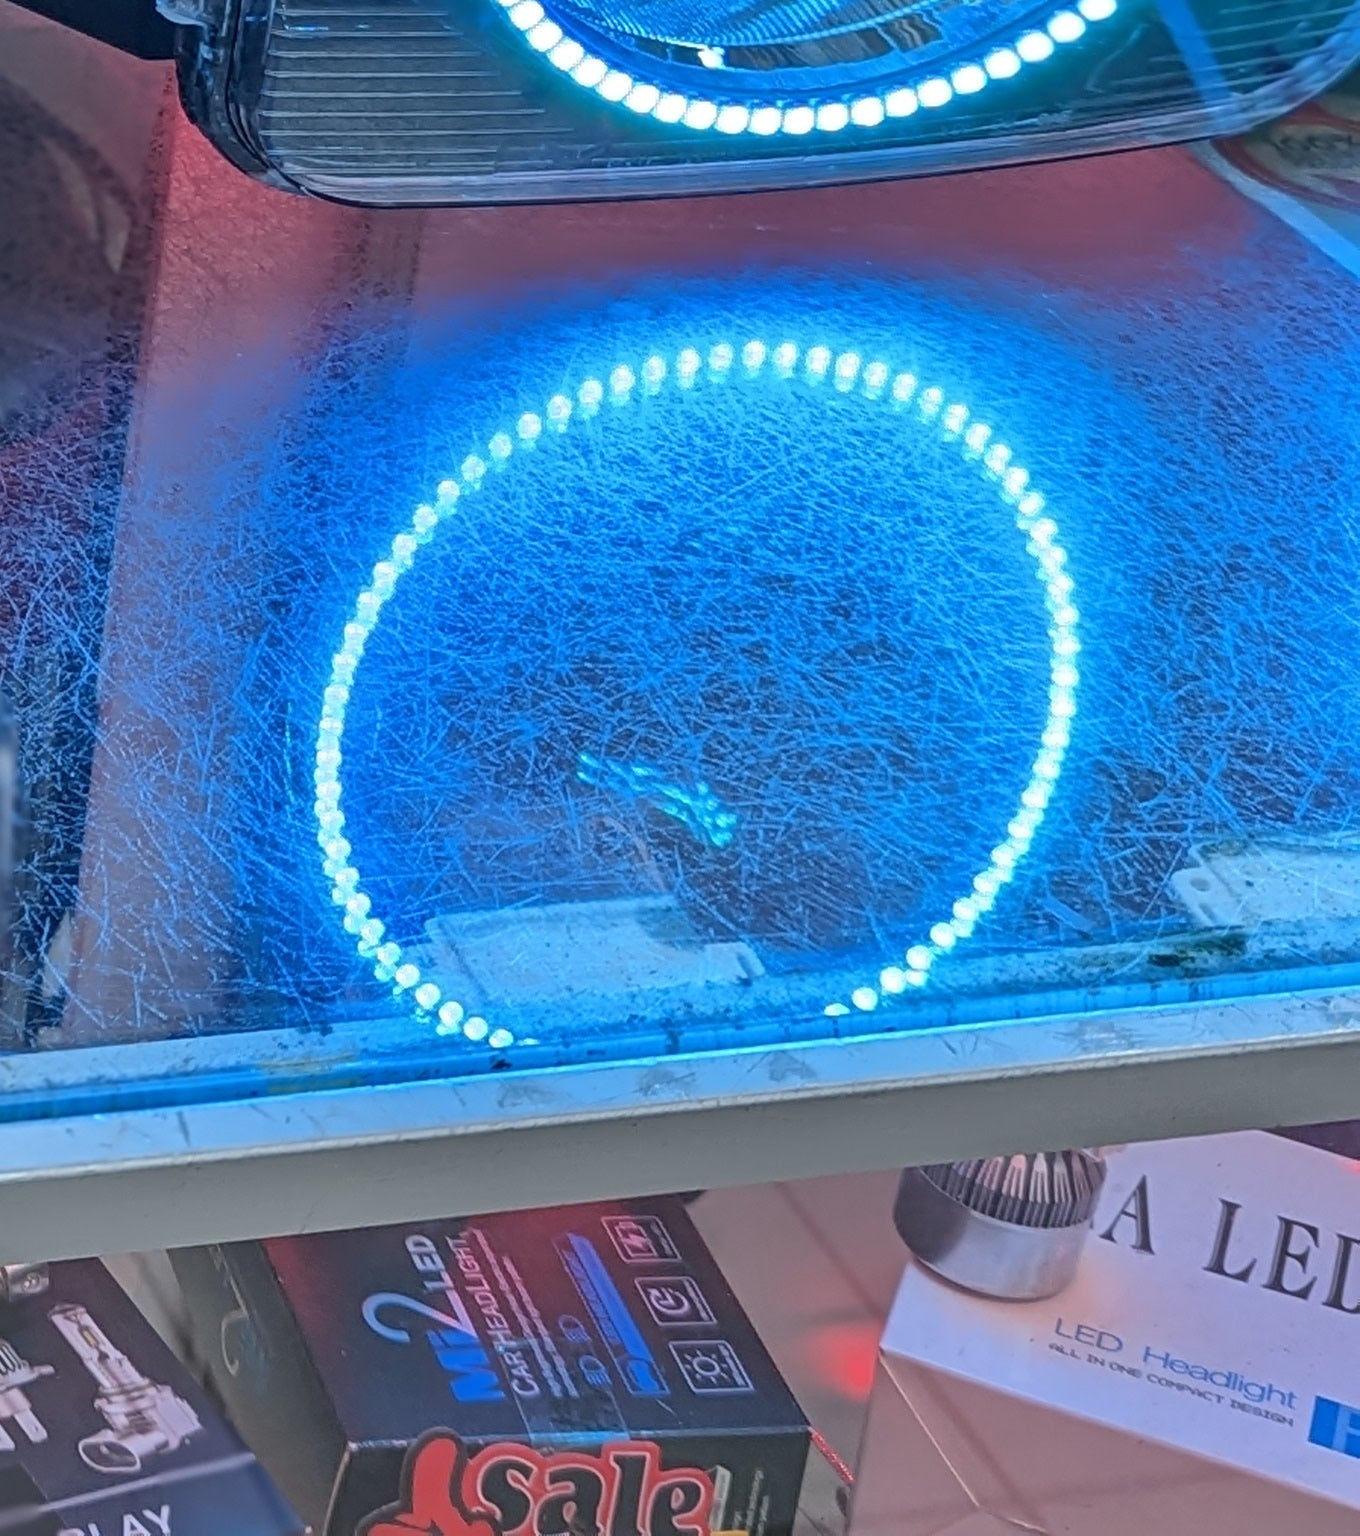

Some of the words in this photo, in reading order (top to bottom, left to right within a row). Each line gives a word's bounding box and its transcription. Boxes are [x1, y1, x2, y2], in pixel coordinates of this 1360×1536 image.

[1089, 1174, 1156, 1256] A
[404, 1234, 455, 1294] LED
[1048, 1341, 1082, 1360] ALL
[1086, 1353, 1106, 1368] IN
[1108, 1361, 1143, 1379] ONE
[1146, 1372, 1226, 1405] COMPACT
[1230, 1398, 1294, 1428] DESIGN
[1054, 1317, 1124, 1353] LED
[1142, 1345, 1299, 1410] Headlight
